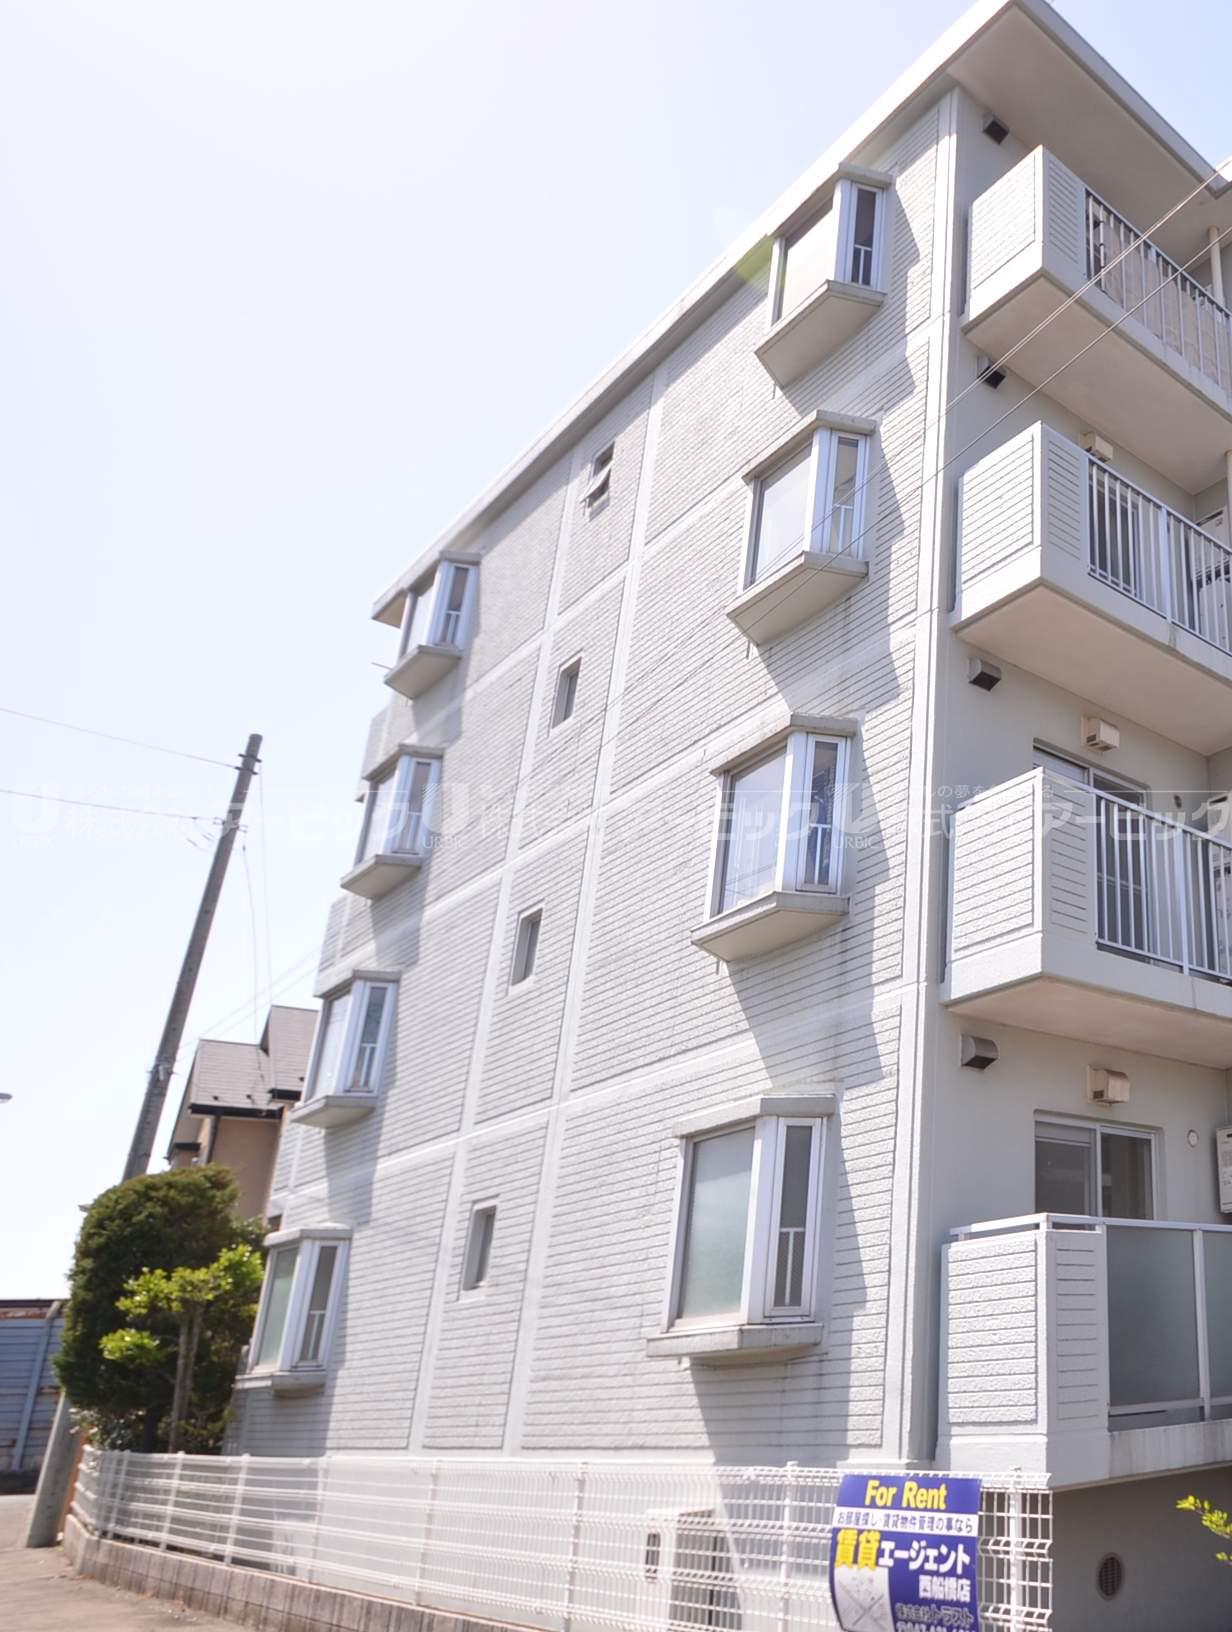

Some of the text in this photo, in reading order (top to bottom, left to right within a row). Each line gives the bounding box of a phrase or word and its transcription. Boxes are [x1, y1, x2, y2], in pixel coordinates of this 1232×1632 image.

[864, 1479, 948, 1510] For Rent
[834, 1528, 971, 1575] 賃貸エージェント
[918, 1574, 972, 1603] 西船橋店
